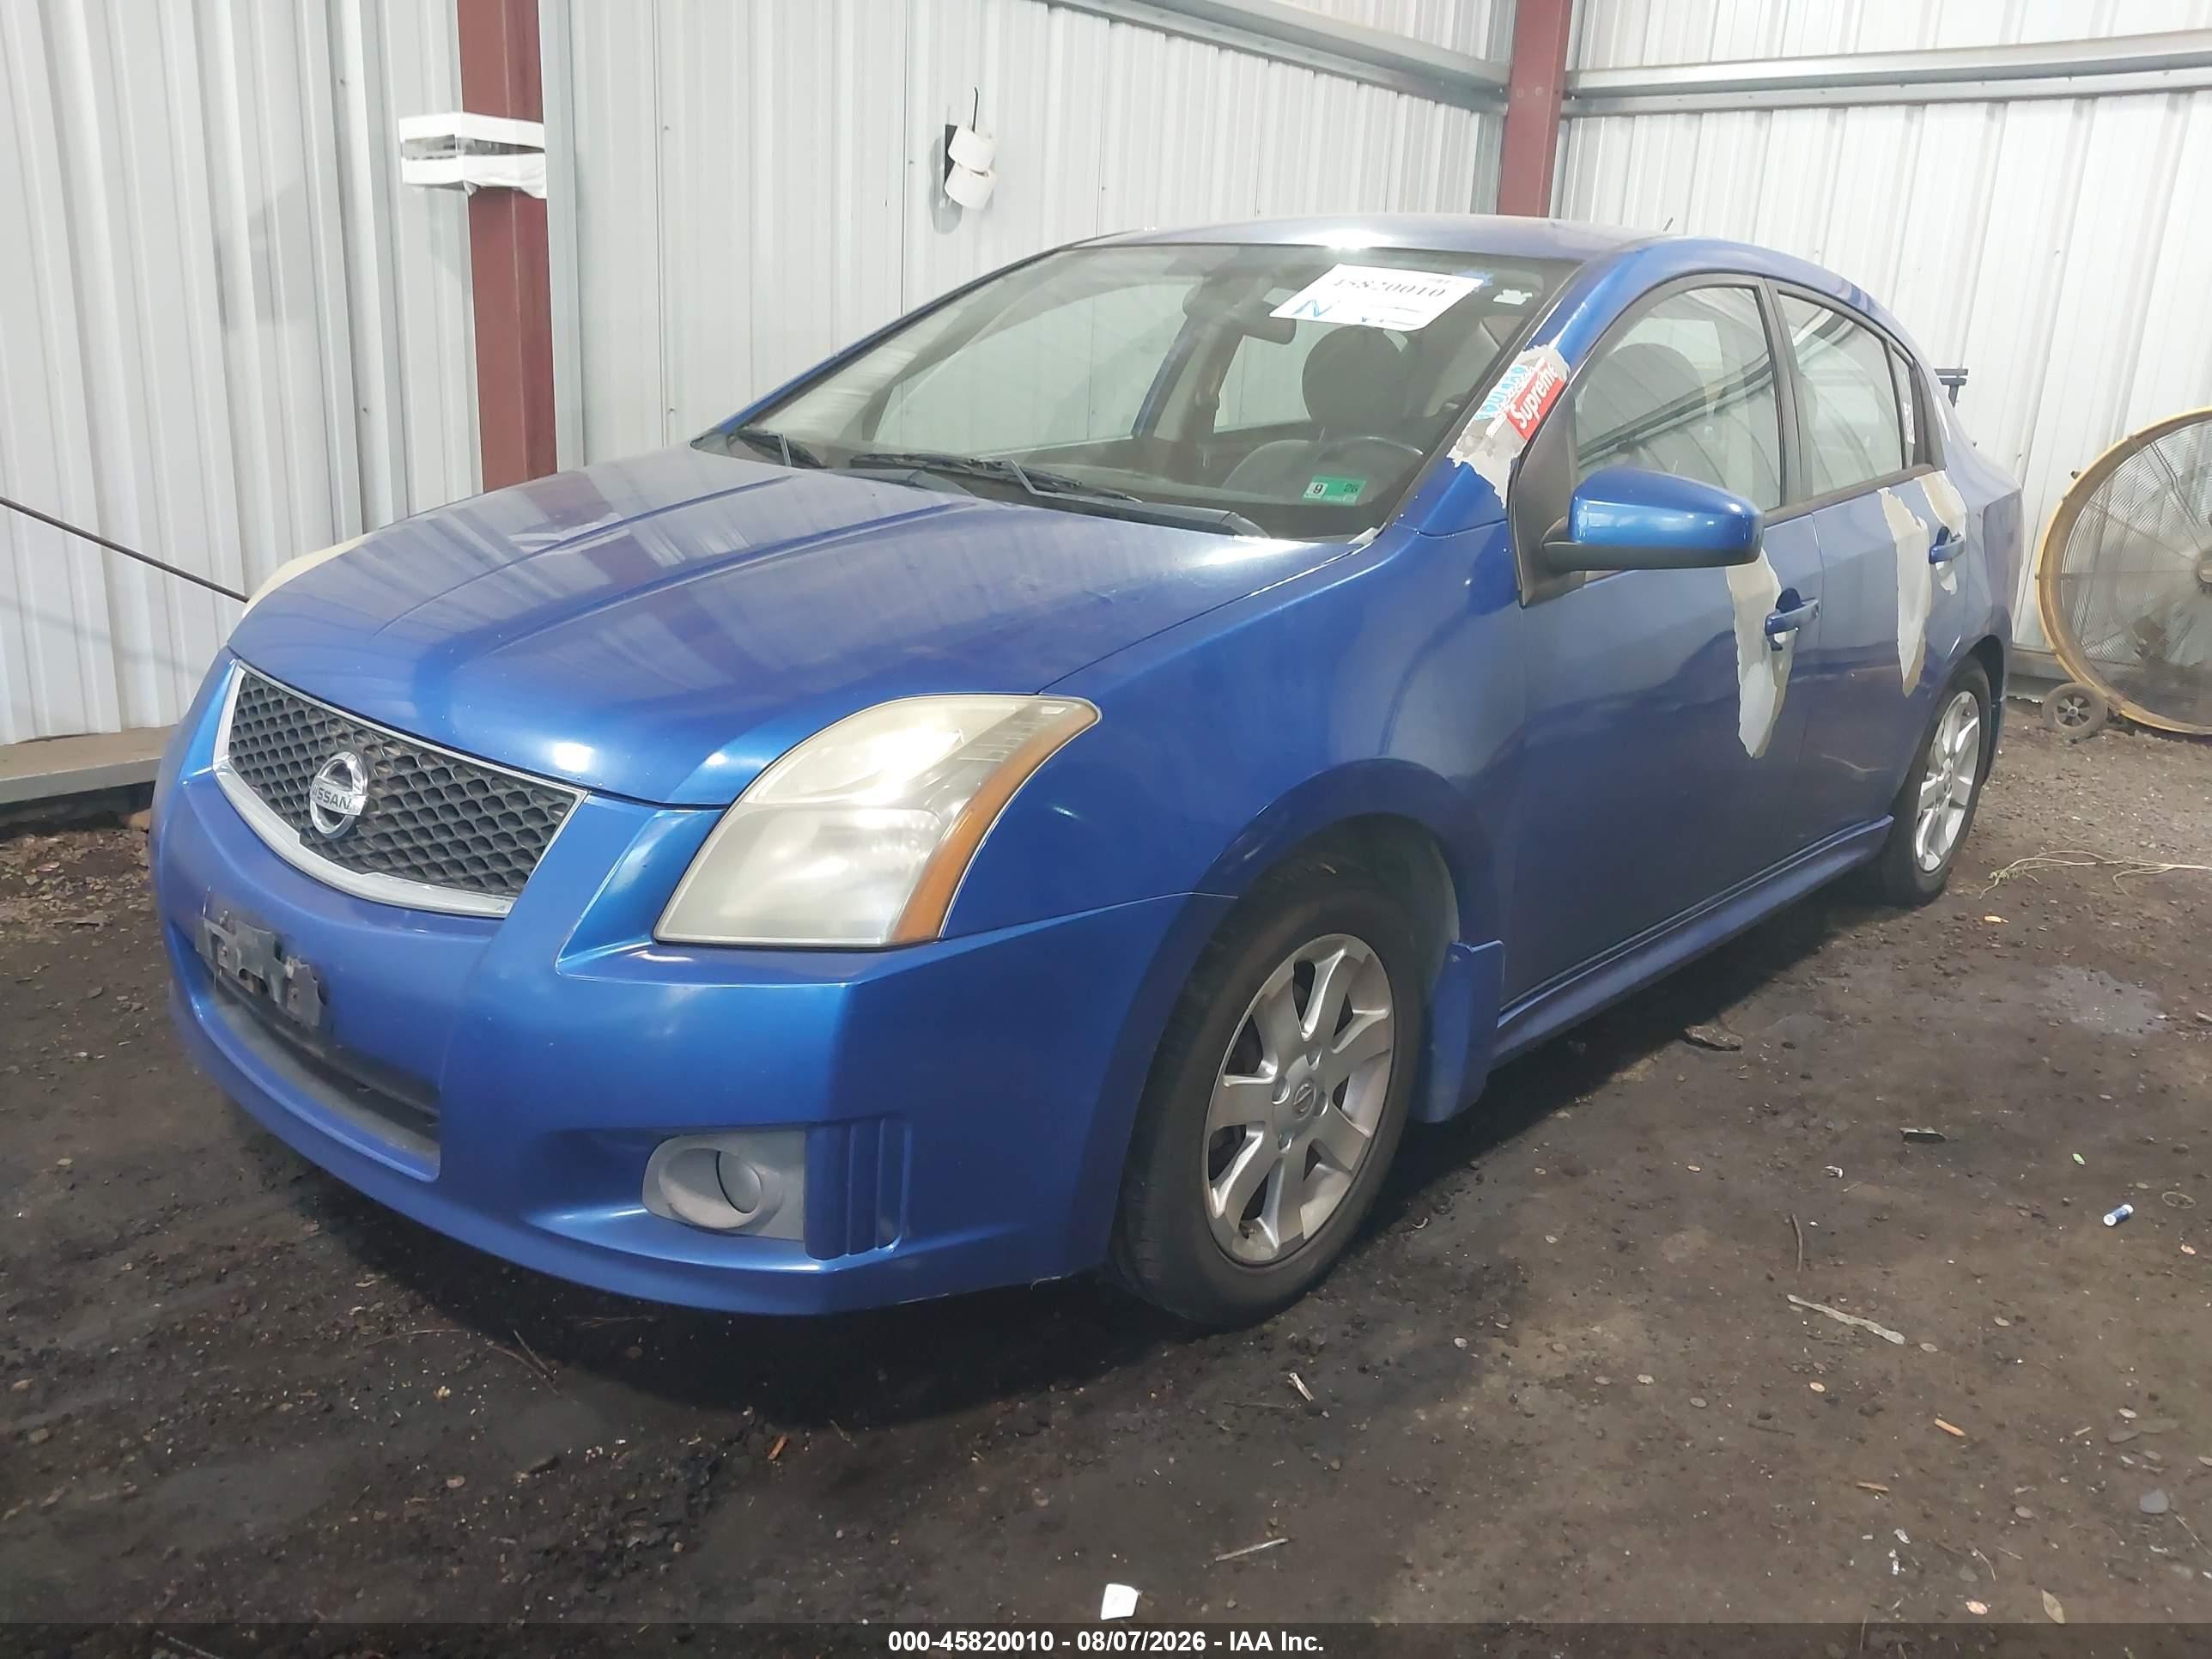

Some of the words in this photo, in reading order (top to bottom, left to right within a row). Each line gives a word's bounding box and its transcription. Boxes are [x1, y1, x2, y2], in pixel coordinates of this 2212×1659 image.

[1510, 364, 1560, 429] Supreme
[1312, 483, 1324, 495] 9
[312, 782, 352, 811] NISSAN
